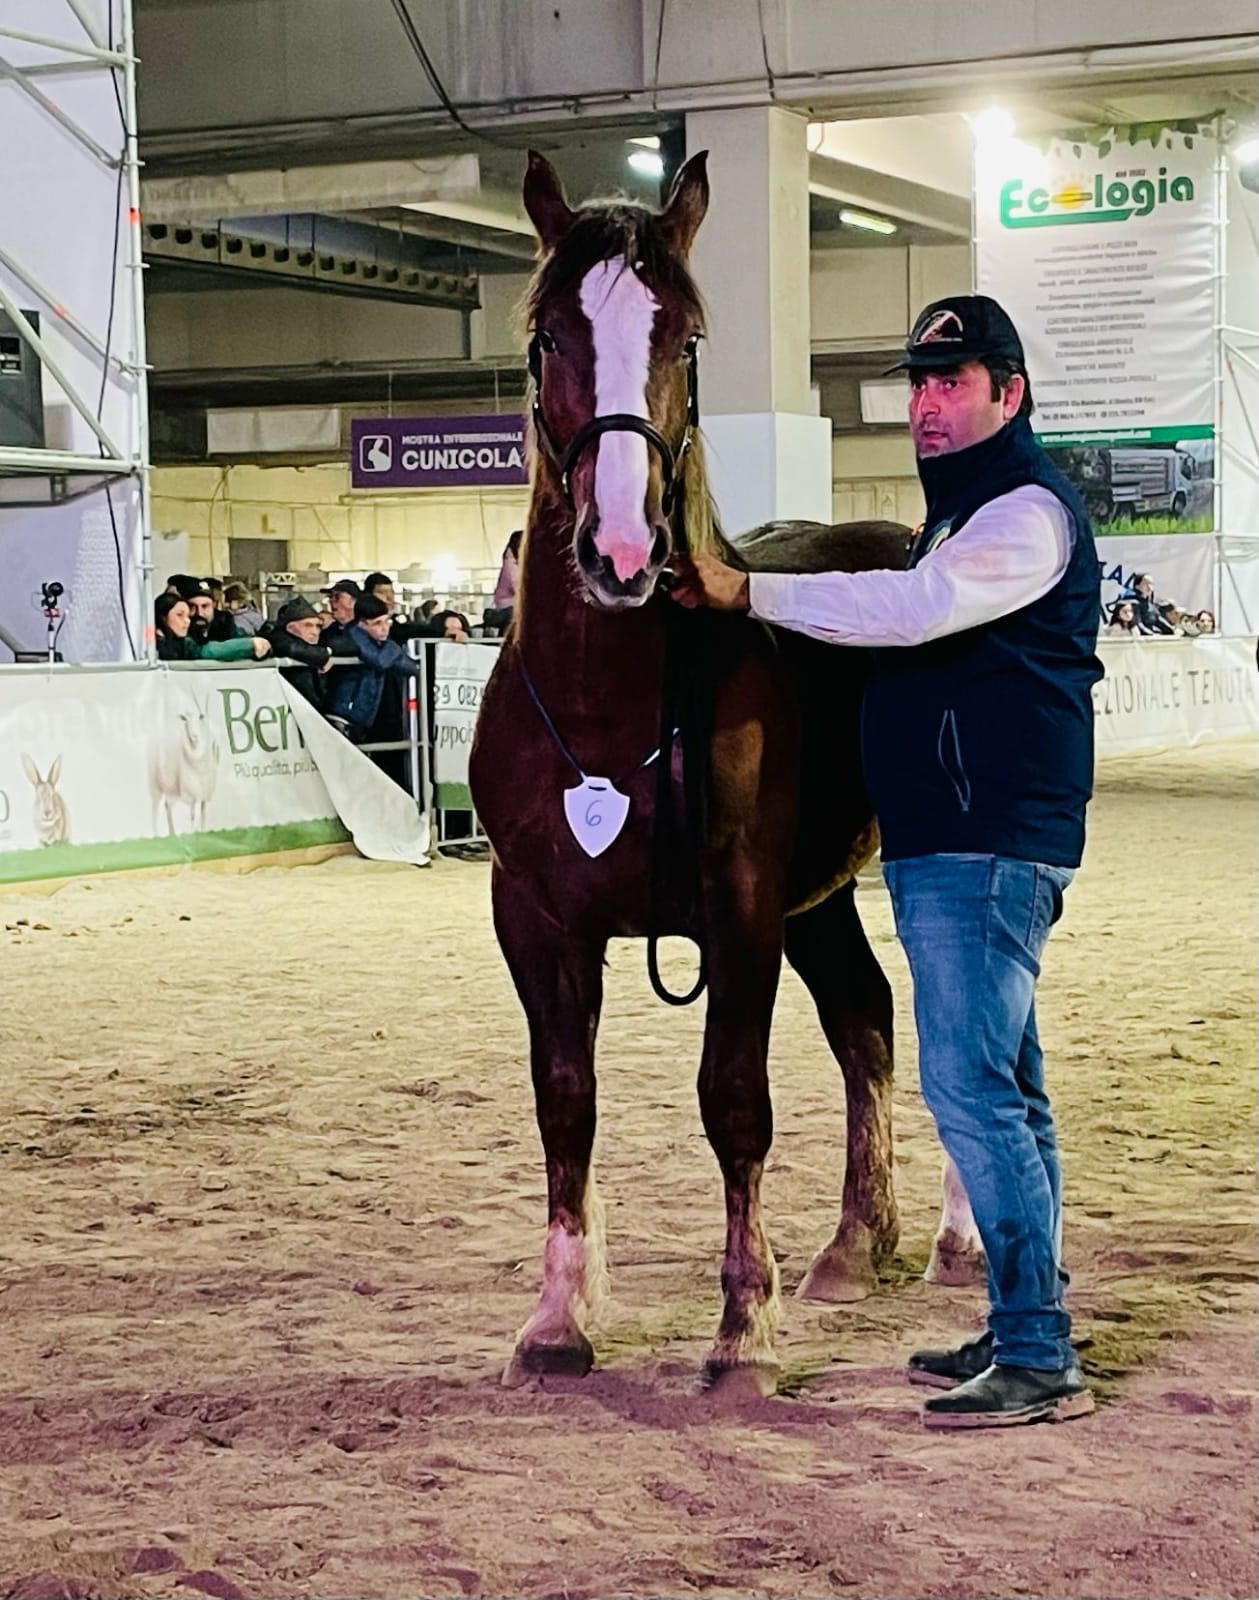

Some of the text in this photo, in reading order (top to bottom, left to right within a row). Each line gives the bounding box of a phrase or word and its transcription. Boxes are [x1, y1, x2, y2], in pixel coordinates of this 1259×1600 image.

[1000, 167, 1194, 229] Ecologia
[402, 434, 441, 445] MOSTRA
[402, 447, 522, 471] CUNICOLA
[585, 799, 603, 827] 6
